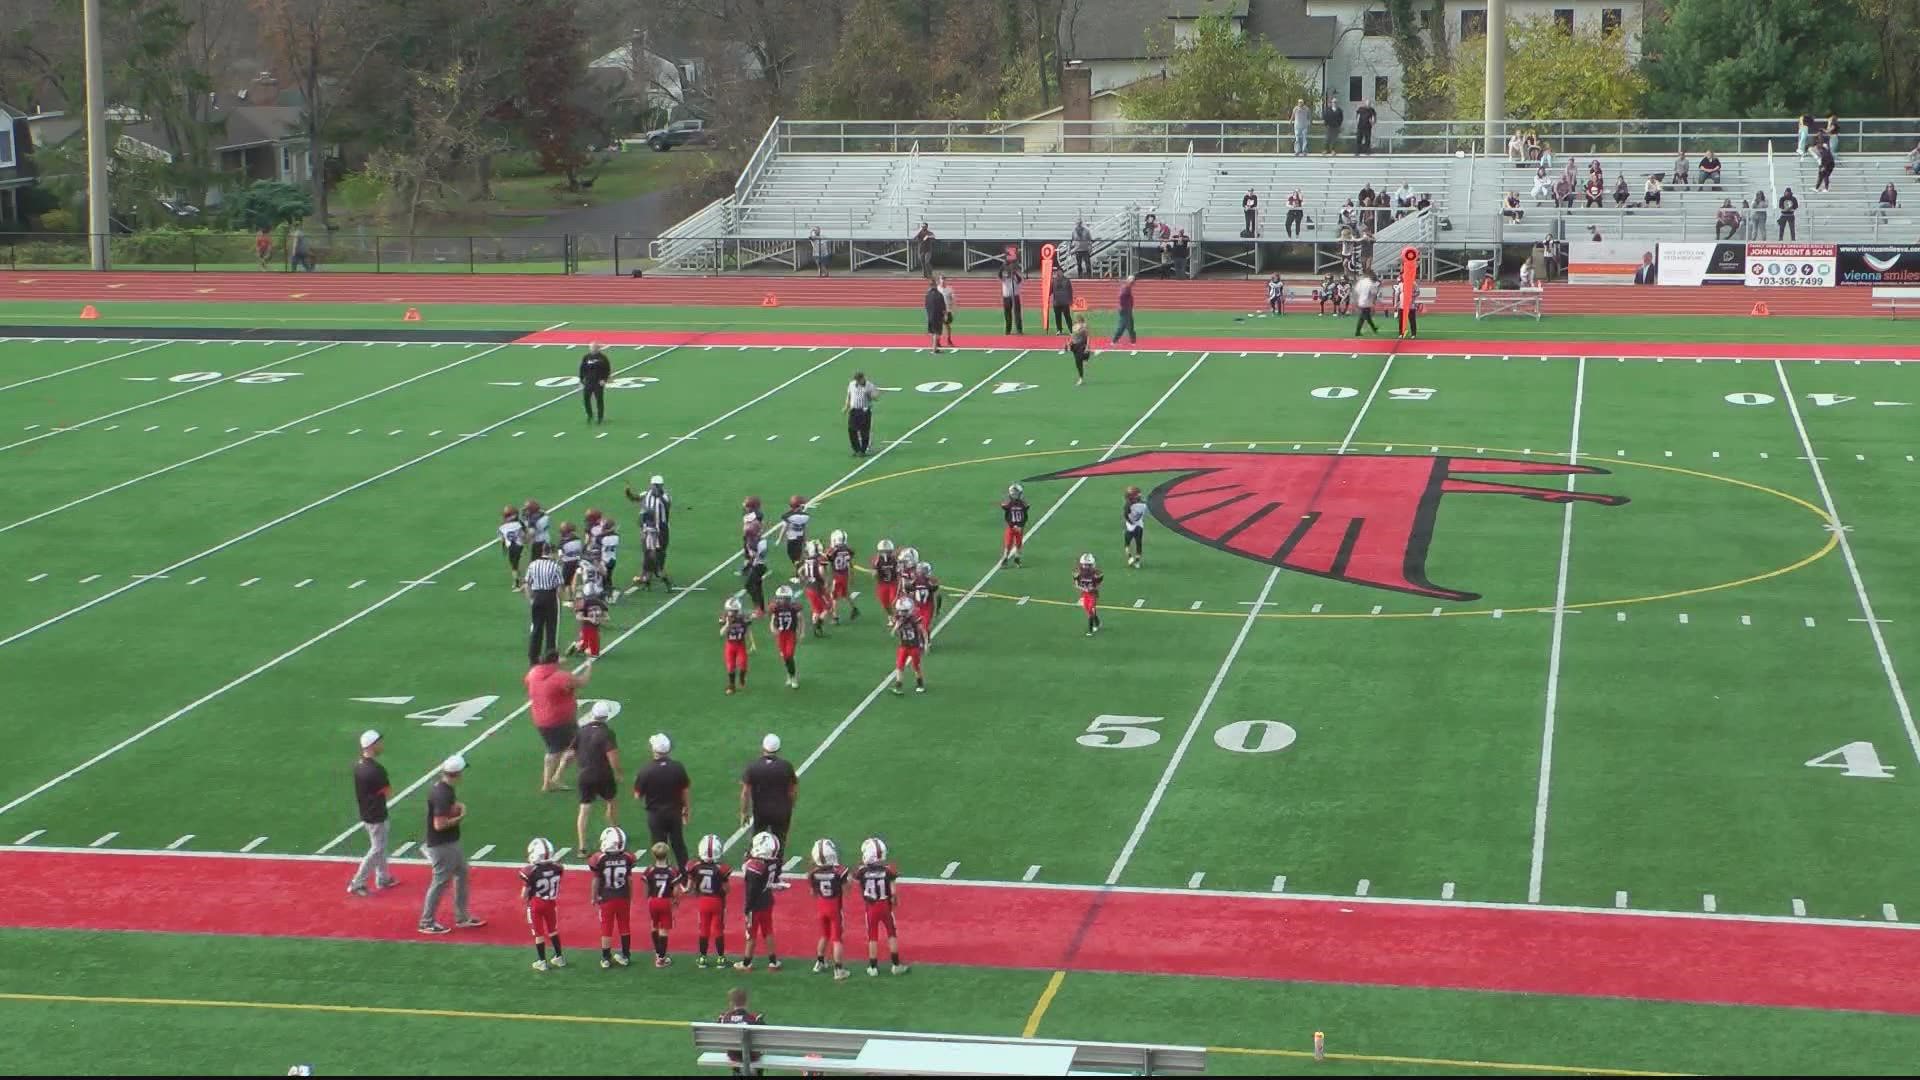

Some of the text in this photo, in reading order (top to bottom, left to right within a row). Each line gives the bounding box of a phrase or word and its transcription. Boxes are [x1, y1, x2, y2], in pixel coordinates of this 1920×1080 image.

[1750, 248, 1772, 256] JOHN
[1772, 248, 1804, 256] NUGENT
[1844, 269, 1920, 280] vienna smiles
[1758, 277, 1824, 286] 703-356-7499
[1804, 741, 1896, 778] 4
[656, 880, 667, 898] 7
